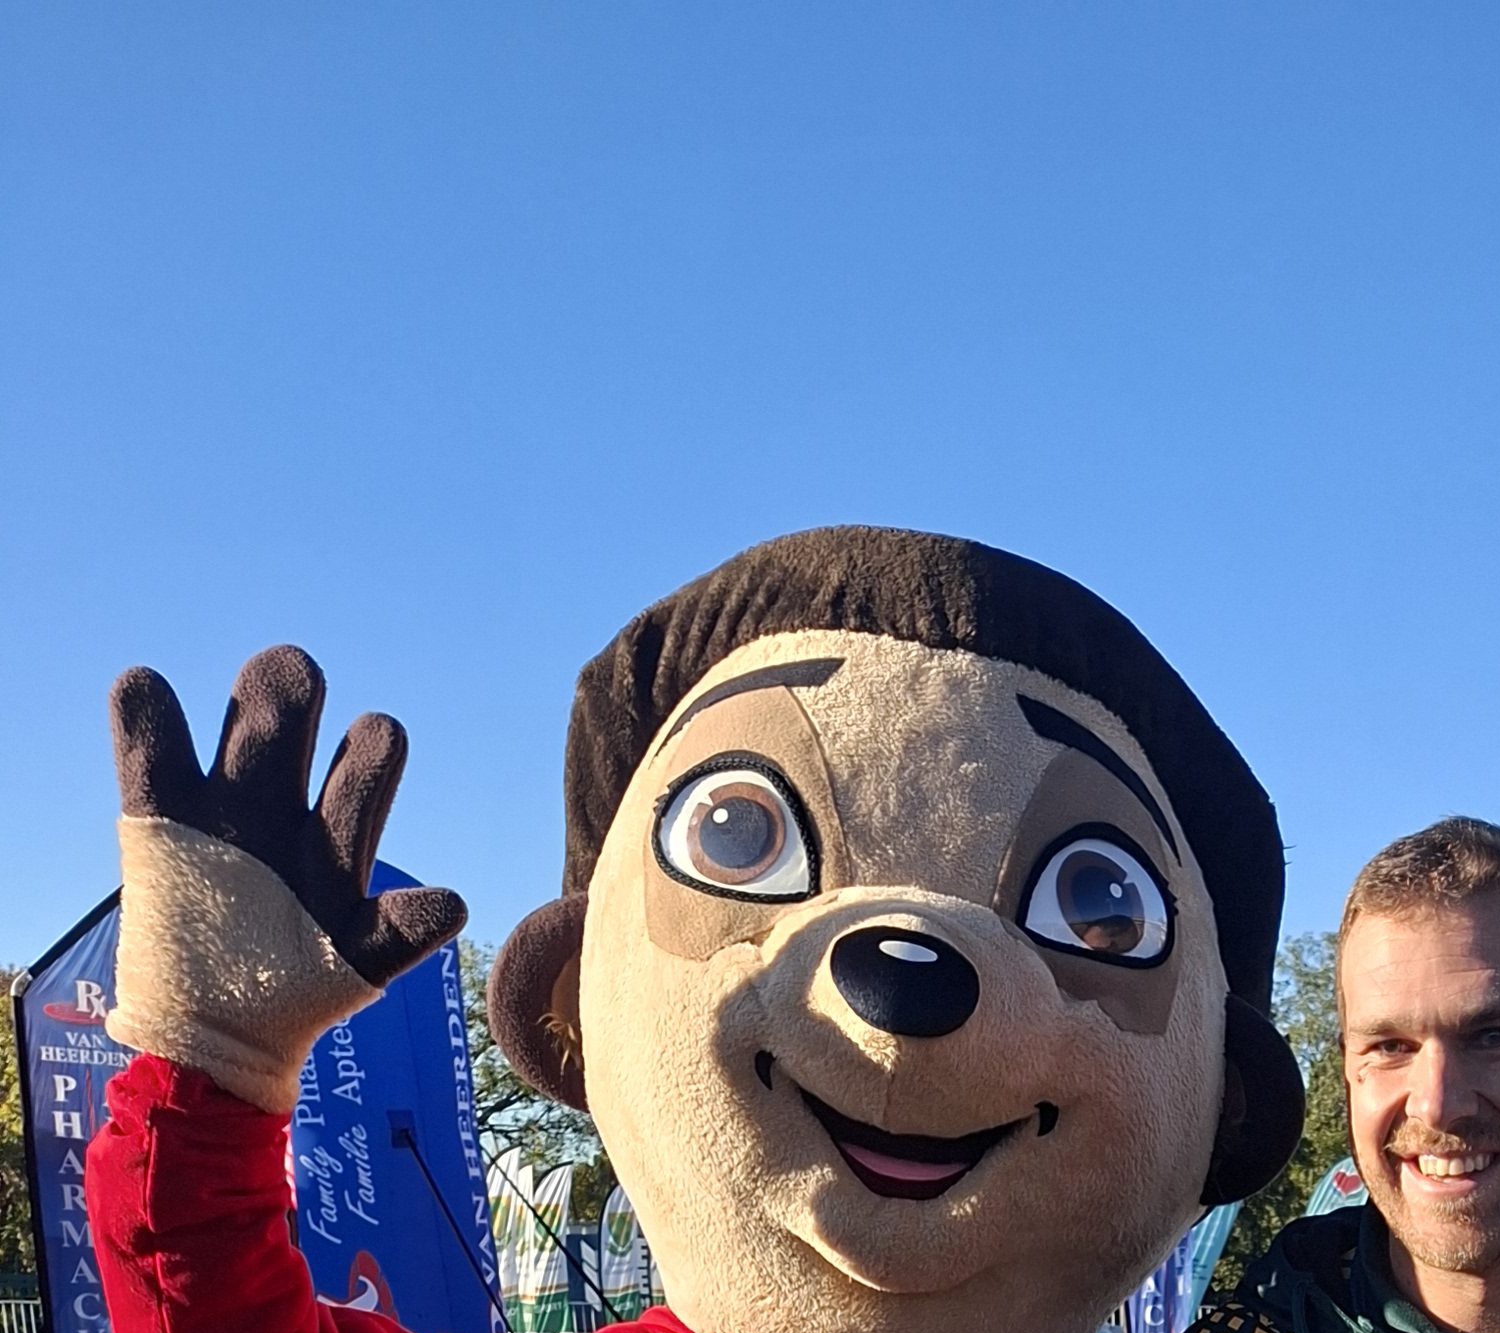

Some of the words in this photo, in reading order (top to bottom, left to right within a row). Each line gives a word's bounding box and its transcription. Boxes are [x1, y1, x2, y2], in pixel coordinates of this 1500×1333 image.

[40, 1046, 132, 1067] HEERDEN
[65, 1032, 106, 1047] VAN
[440, 947, 483, 1181] HEERDEN
[299, 1146, 343, 1245] Family
[338, 1122, 379, 1226] Familie
